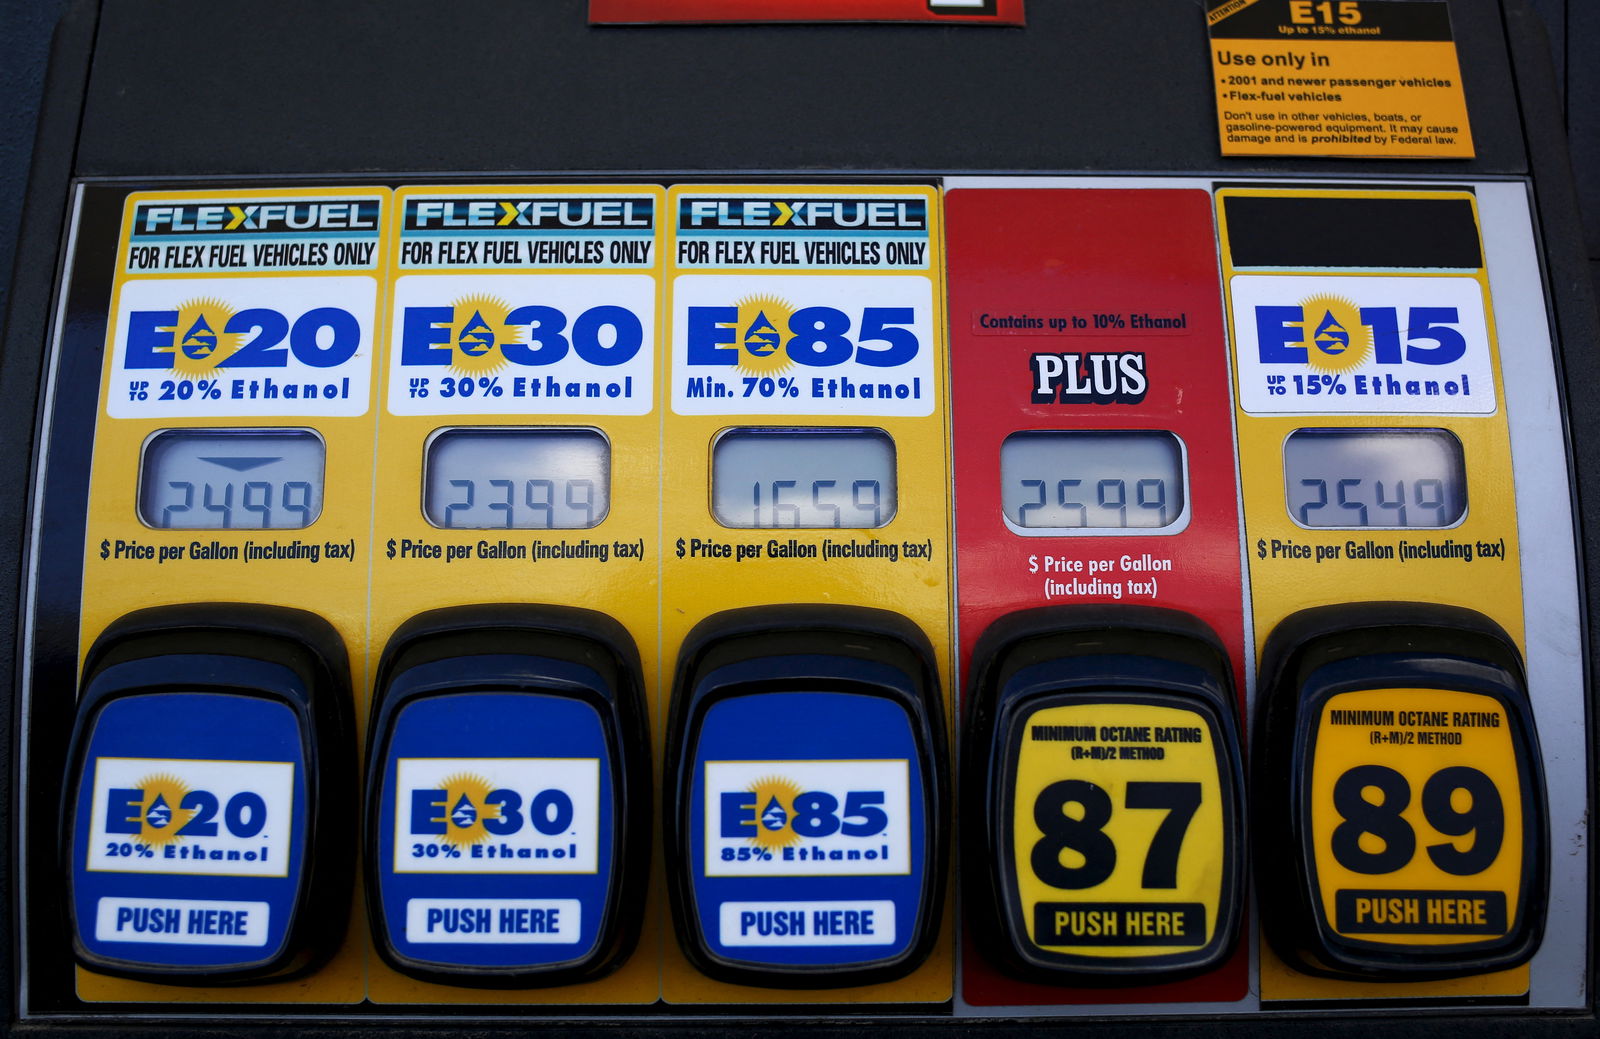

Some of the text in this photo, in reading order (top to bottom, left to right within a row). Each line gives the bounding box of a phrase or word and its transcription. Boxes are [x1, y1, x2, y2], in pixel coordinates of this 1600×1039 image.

[1289, 1, 1362, 25] E15
[1278, 25, 1381, 35] Up to 15% ethanol
[1218, 51, 1330, 70] Use only in
[1228, 76, 1451, 89] 2001 and newer passenger vehicles
[1230, 91, 1342, 101] Flex-fuel vehicles
[1224, 111, 1252, 121] Don't
[1278, 112, 1288, 120] in
[1291, 112, 1319, 121] other
[1323, 112, 1370, 122] vehicles,
[1374, 113, 1407, 122] boats,
[1226, 123, 1458, 135] gasoline-powered equipment. It may cause
[1227, 134, 1271, 144] damage
[1275, 135, 1295, 143] and
[1311, 135, 1371, 143] prohibited
[1374, 136, 1387, 145] by
[1391, 136, 1432, 144] Federal
[1436, 136, 1456, 144] law.
[145, 204, 373, 232] FLEXFUEL
[416, 202, 648, 227] FLEXFUEL
[691, 202, 922, 227] FLEXFUEL
[129, 242, 375, 269] FOR FLEX FUEL VEHICLES ONLY
[402, 241, 651, 264] FOR FLEX FUEL VEHICLES ONLY
[678, 241, 926, 265] FOR FLEX FUEL VEHICLES ONLY
[980, 313, 1186, 332] Contains up to 10% Ethanol
[130, 381, 149, 391] UP
[410, 378, 429, 388] UP
[410, 376, 632, 398] TO 30% Ethanol
[686, 376, 921, 399] Min. 70% Ethanol
[1030, 351, 1149, 404] PLUS
[1266, 376, 1286, 384] UP
[1268, 374, 1470, 396] TO 15% Ethanol
[129, 378, 350, 401] TO 20% Ethanol
[100, 539, 355, 563] $ Price per Gallon (including tax)
[387, 538, 644, 562] $ Price per Gallon (including tax)
[675, 538, 932, 562] $ Price per Gallon (including tax)
[1257, 538, 1505, 563] $ Price per Gallon (including tax)
[1029, 554, 1172, 575] $ Price per Gallon
[1044, 577, 1158, 599] (including tax)
[1331, 710, 1500, 727] MINIMUM OCTANE RATING
[1032, 726, 1202, 743] MINIMUM OCTANE RATING
[1370, 731, 1462, 745] (R+M)/2 METHOD
[1071, 747, 1165, 761] (R+M)/2 METHOD
[1331, 765, 1505, 876] 89
[1031, 779, 1202, 890] 87
[105, 843, 268, 862] 20% Ethanol
[412, 844, 576, 859] 30% Ethanol
[720, 846, 888, 862] 85% Ethanol
[116, 907, 248, 936] PUSH HERE
[427, 908, 560, 933] PUSH HERE
[1356, 898, 1487, 925] PUSH HERE
[741, 910, 874, 936] PUSH HERE
[1055, 912, 1185, 936] PUSH HERE
